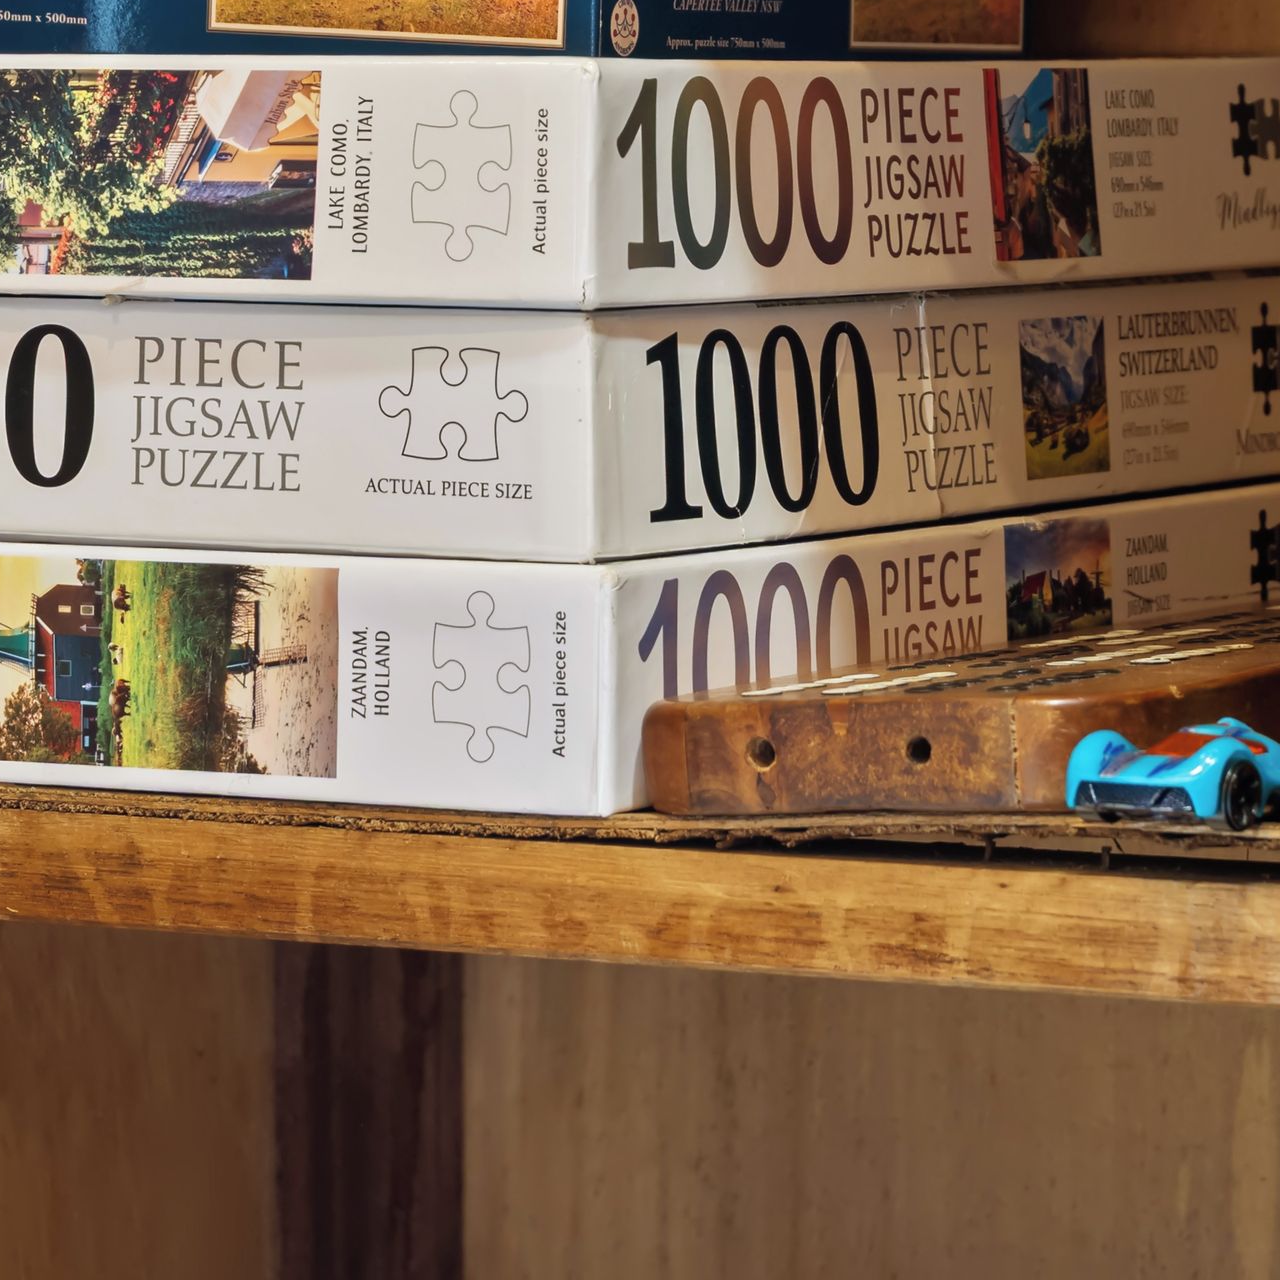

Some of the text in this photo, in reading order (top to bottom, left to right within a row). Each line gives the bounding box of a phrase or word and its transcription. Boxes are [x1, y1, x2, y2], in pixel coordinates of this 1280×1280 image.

[45, 12, 88, 26] 500mm
[761, 0, 783, 14] NSW
[356, 95, 374, 142] ITALY
[860, 87, 964, 144] PIECE
[1104, 89, 1127, 109] LAKE
[1156, 117, 1179, 137] ITALY
[531, 108, 551, 255] Actual piece size
[616, 75, 854, 271] 1000
[864, 154, 965, 209] JIGSAW
[328, 185, 346, 230] LAKE
[867, 211, 972, 259] PUZZLE
[133, 335, 304, 391] PIECE
[893, 322, 992, 382] PIECE
[1119, 345, 1218, 378] SWITZERLAND
[131, 395, 305, 443] JIGSAW
[646, 321, 880, 524] 1000
[898, 386, 993, 446] JIGSAW
[131, 447, 302, 493] PUZZLE
[365, 477, 533, 500] ACTUAL PIECE SIZE
[904, 442, 998, 494] PUZZLE
[880, 547, 983, 617] PIECE
[1126, 561, 1168, 586] HOLLAND
[638, 553, 871, 701] 1000
[373, 629, 391, 716] HOLLAND
[551, 610, 569, 757] Actual piece size
